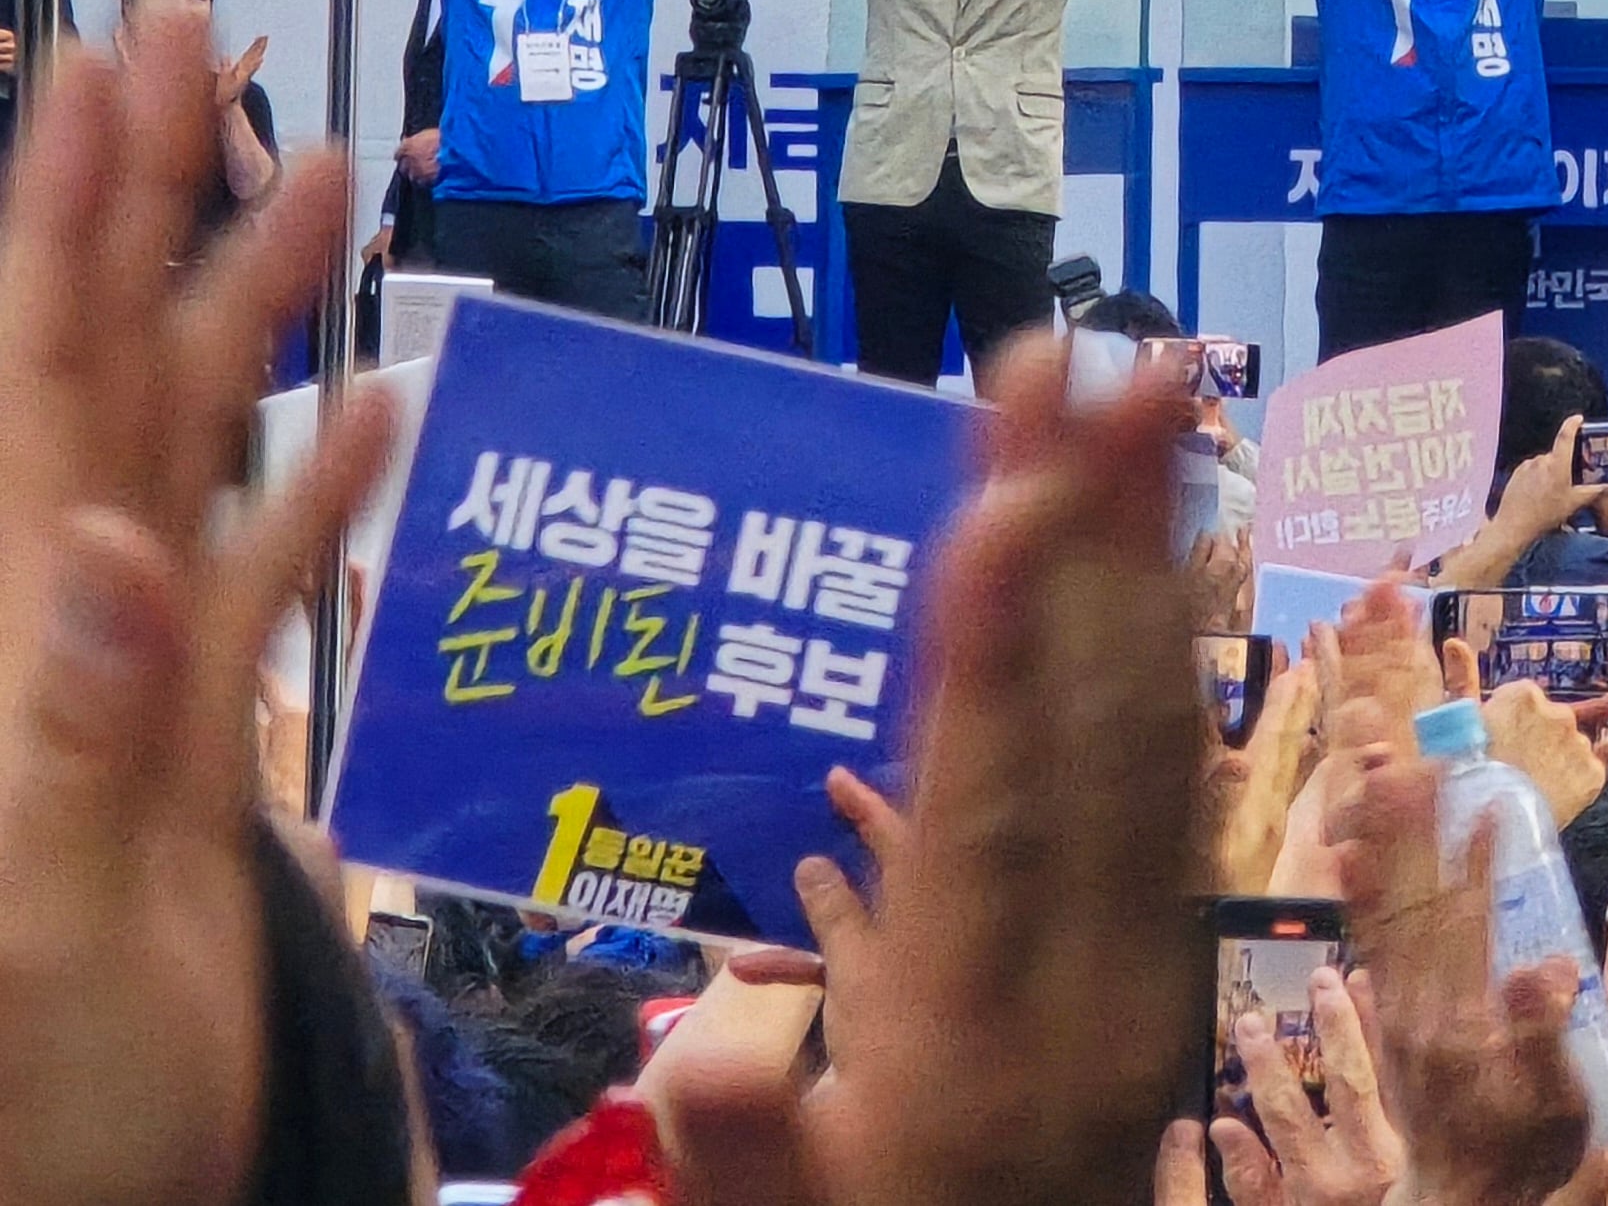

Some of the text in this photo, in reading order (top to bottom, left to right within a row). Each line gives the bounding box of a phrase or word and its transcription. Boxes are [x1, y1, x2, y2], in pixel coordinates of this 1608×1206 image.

[446, 450, 914, 631] 세상을 바꿀
[437, 548, 890, 742] 준비된 후보
[531, 782, 600, 907] 1
[568, 870, 694, 926] 이재명
